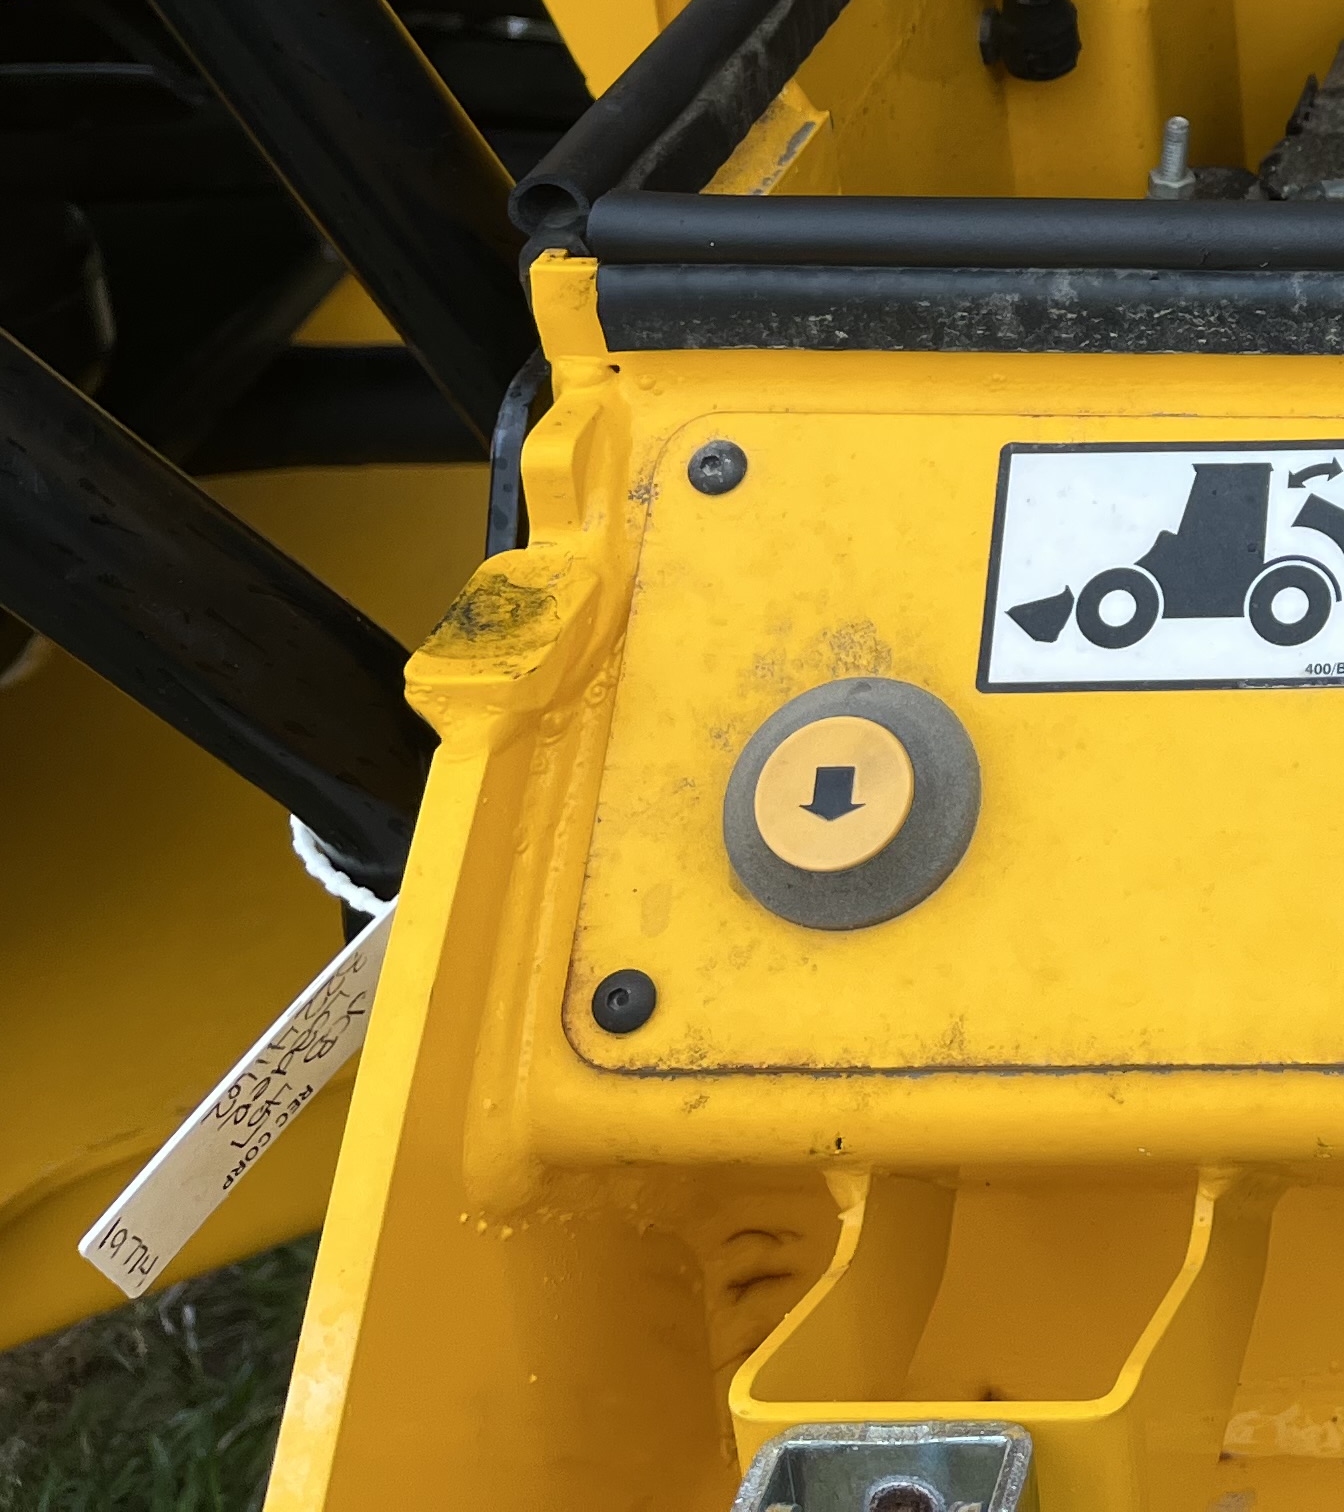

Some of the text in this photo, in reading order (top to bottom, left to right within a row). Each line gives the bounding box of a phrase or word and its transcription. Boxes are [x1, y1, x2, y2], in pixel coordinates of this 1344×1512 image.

[230, 990, 367, 1148] JCB 457
[223, 1085, 313, 1190] REC CORP
